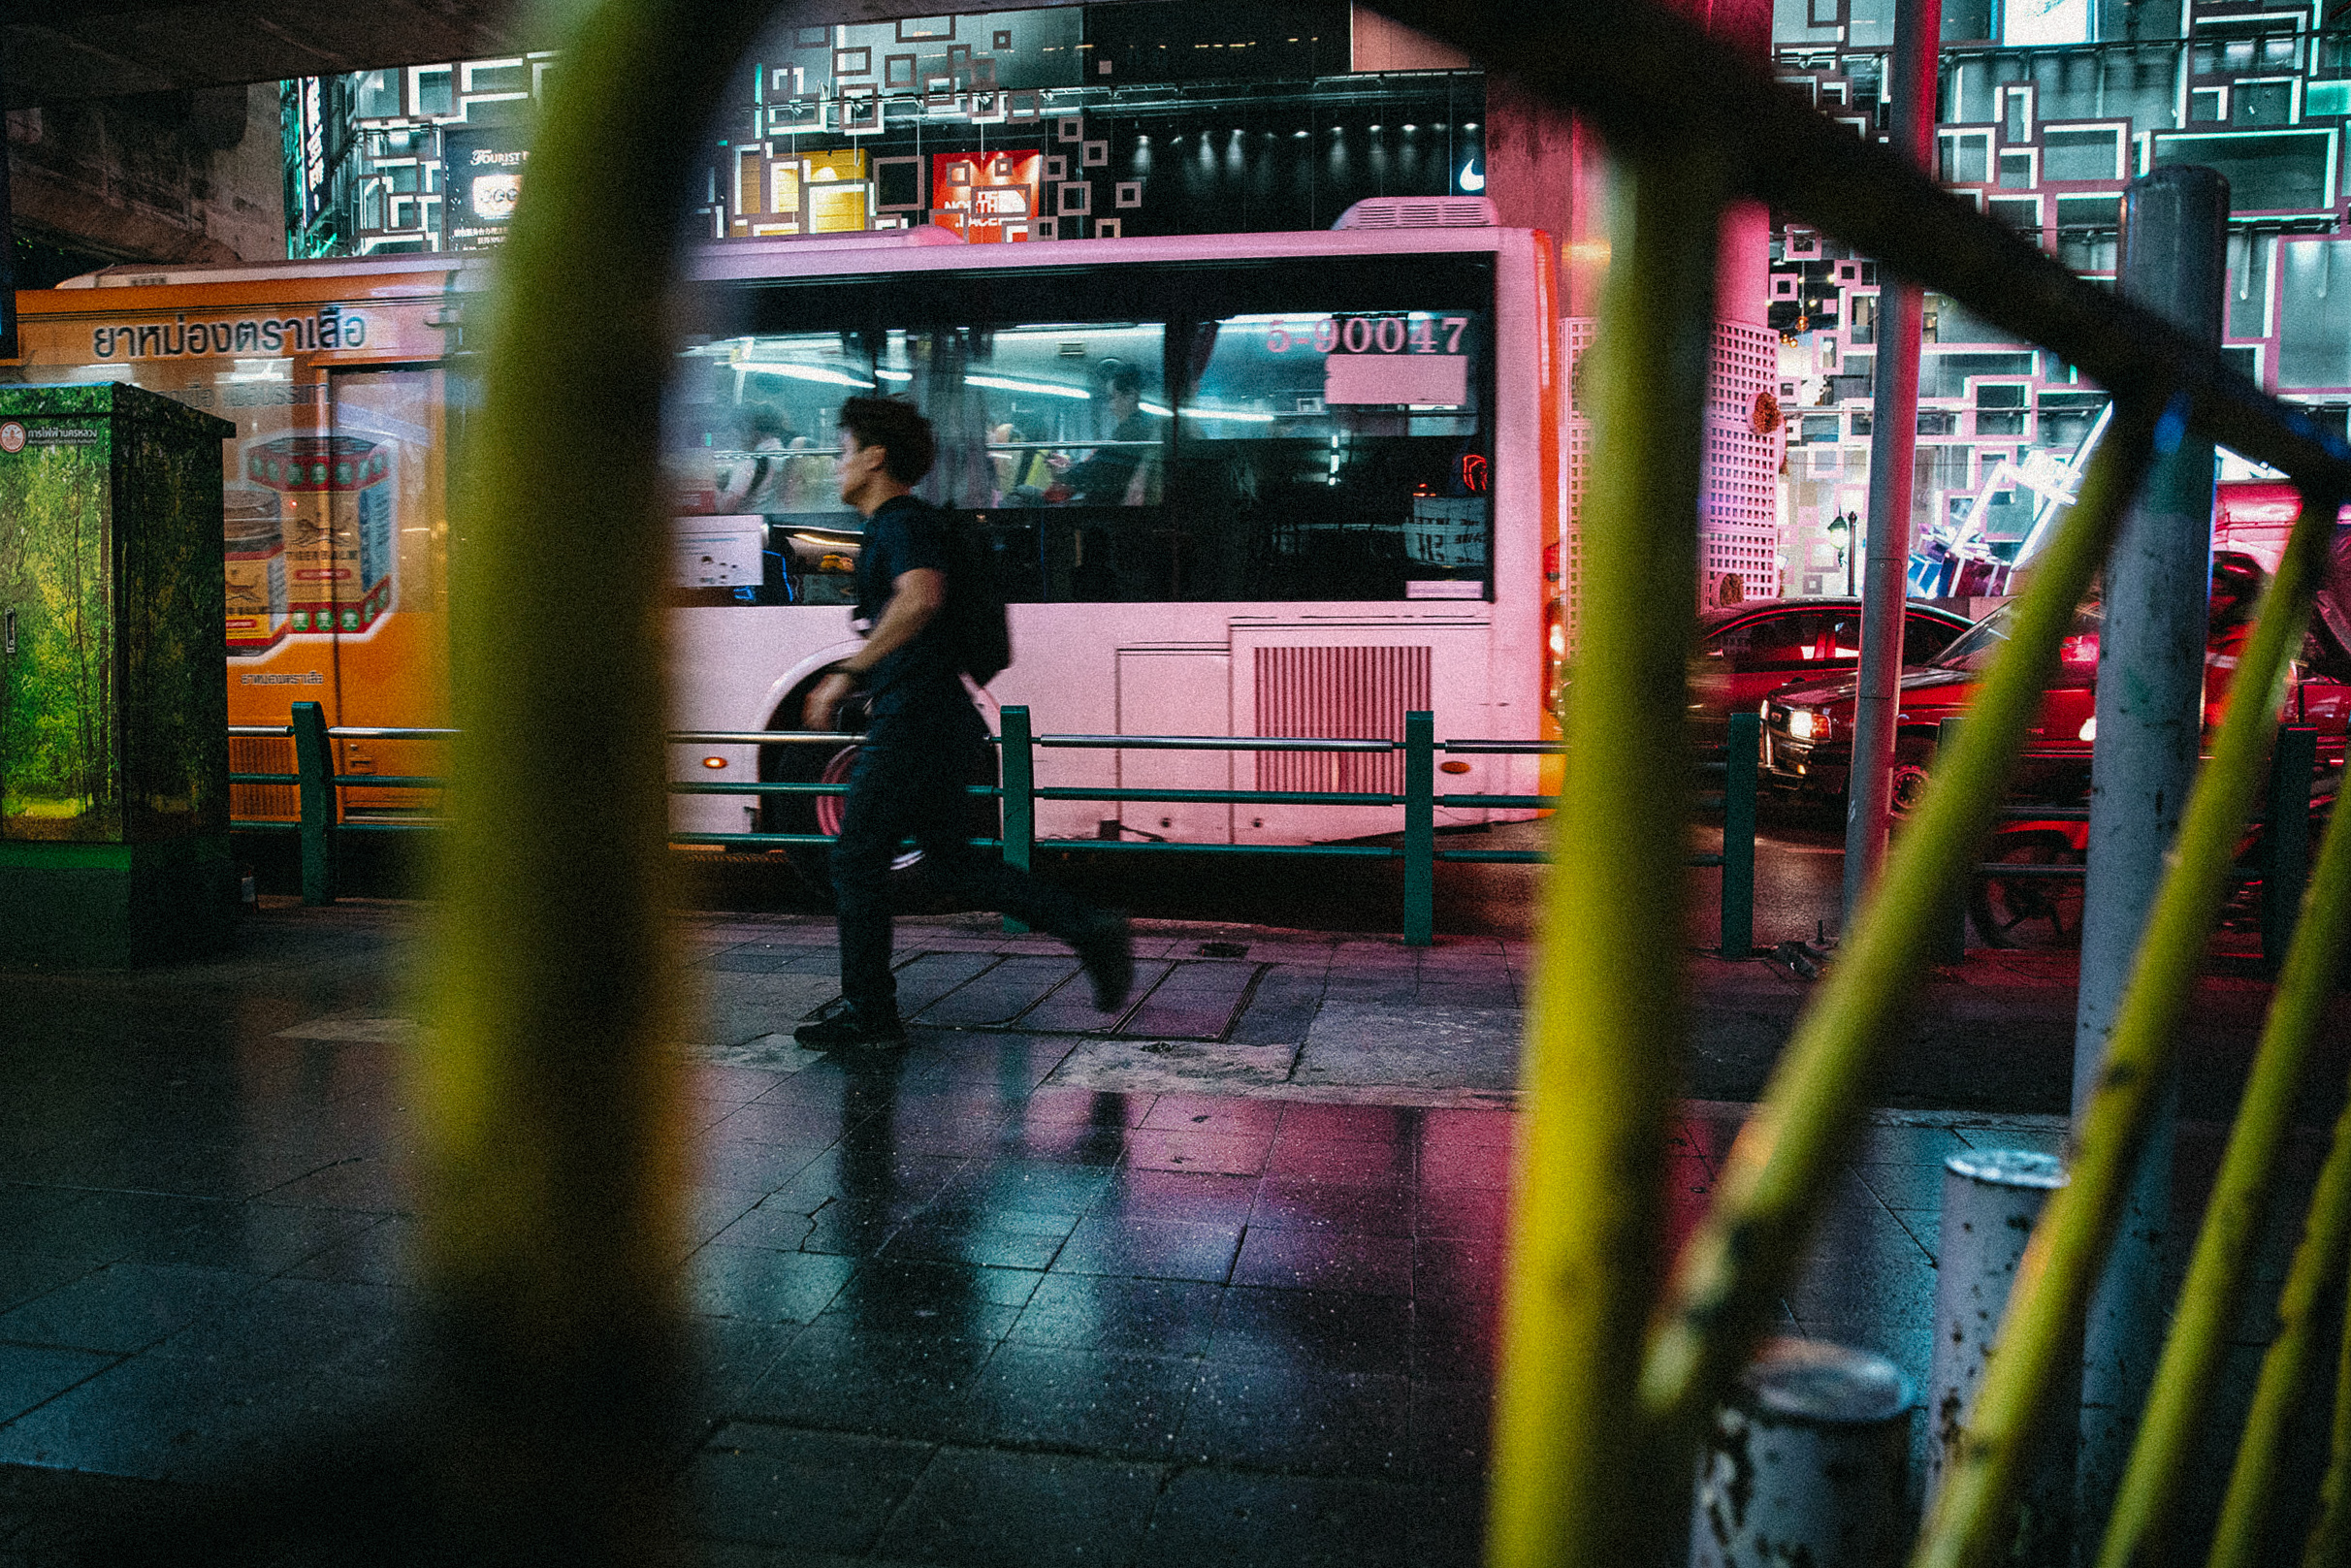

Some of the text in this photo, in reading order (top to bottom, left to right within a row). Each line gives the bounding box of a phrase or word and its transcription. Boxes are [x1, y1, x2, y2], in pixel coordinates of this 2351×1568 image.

[93, 304, 367, 358] ยาหม่องตราเสือ
[1267, 317, 1469, 353] 5-90047
[27, 426, 97, 438] การไฟฟ้านครหลวง
